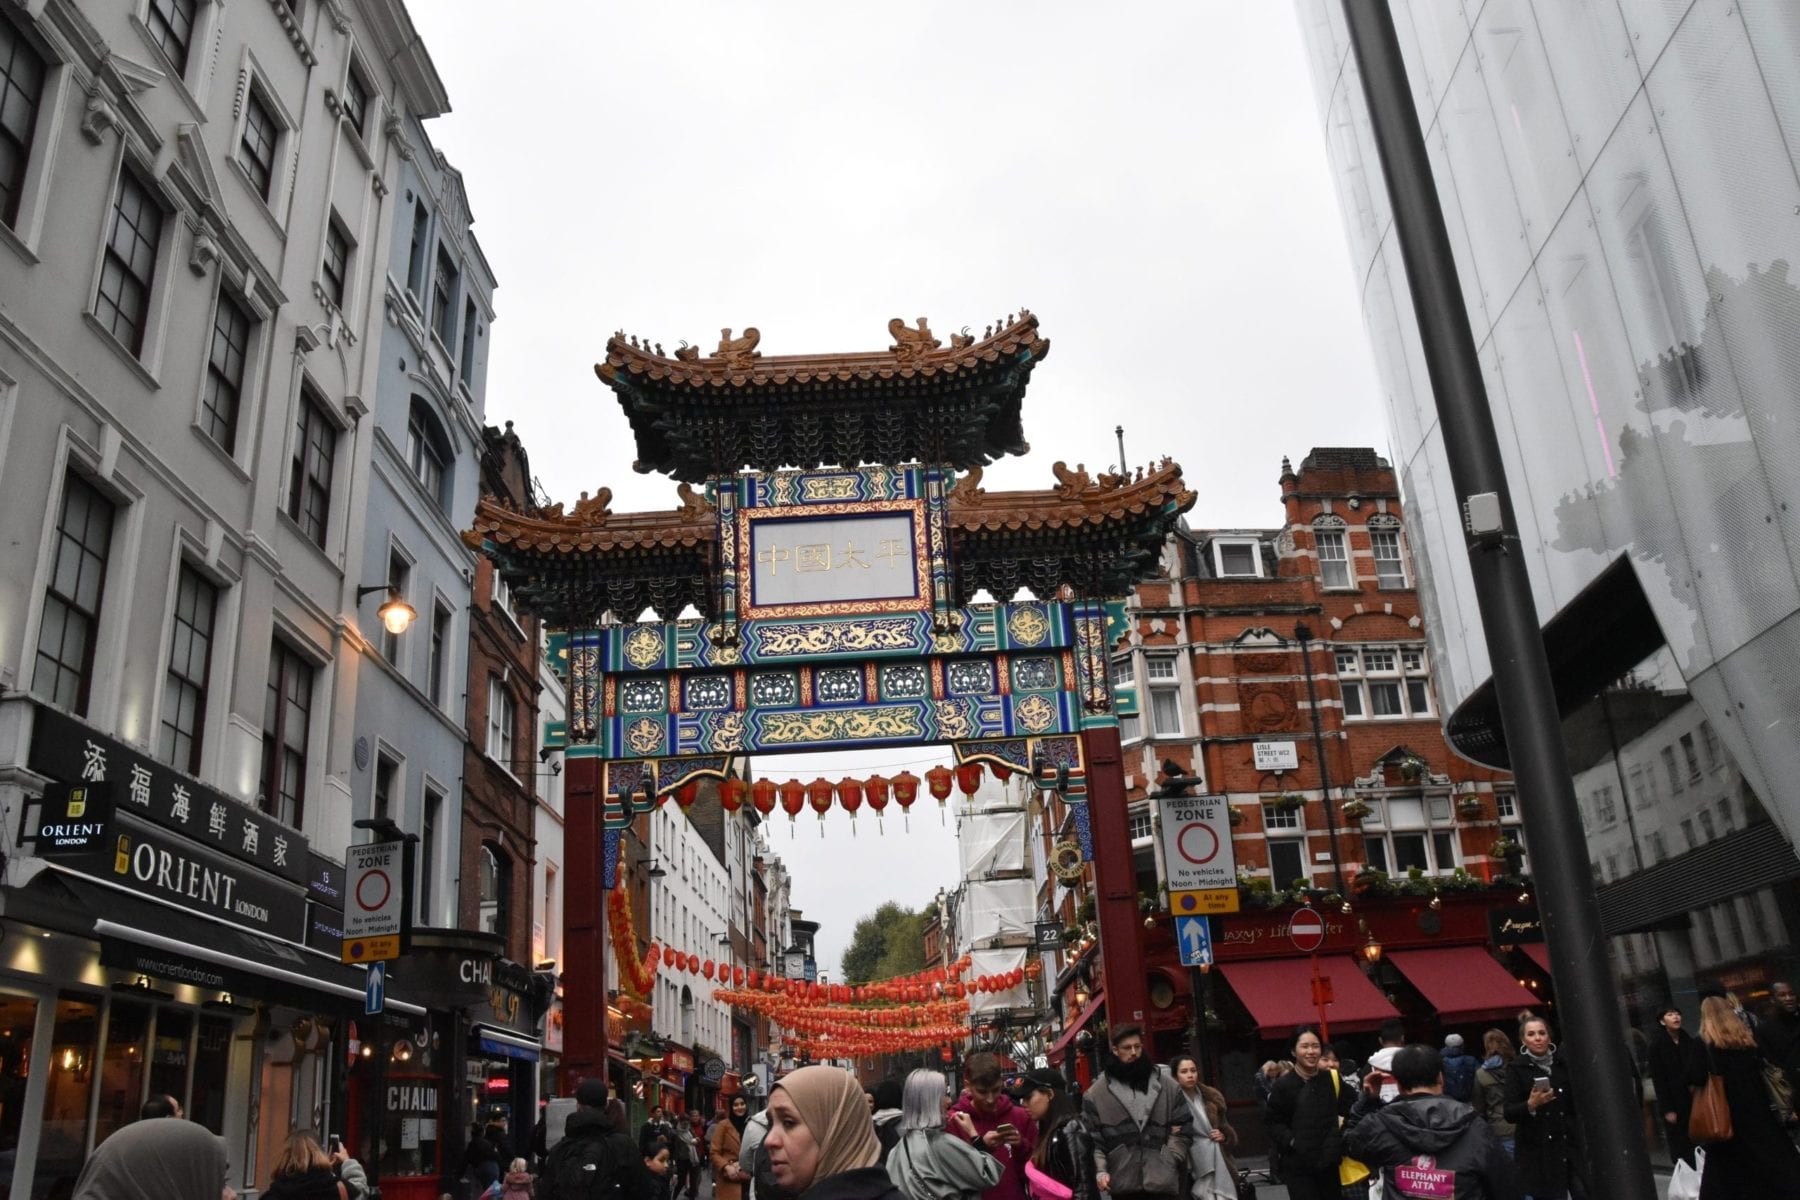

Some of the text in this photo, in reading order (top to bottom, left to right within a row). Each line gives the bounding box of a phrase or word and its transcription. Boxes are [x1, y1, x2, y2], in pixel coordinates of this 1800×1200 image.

[1166, 798, 1221, 809] PEDESTRIAN
[1175, 808, 1215, 822] ZONE
[41, 823, 104, 837] ORIENT
[55, 838, 88, 846] LONDON
[352, 845, 398, 856] PEDESTRIAN
[358, 856, 391, 869] ZONE
[1178, 868, 1224, 877] No vehicles
[133, 843, 269, 923] ORIENT LONDON
[1198, 878, 1233, 888] Midnight
[352, 914, 392, 925] No vehicles
[346, 928, 364, 936] Noon
[368, 924, 398, 932] Midnight
[1042, 930, 1058, 941] 22
[1400, 1170, 1447, 1183] ELEPHANT
[1411, 1180, 1435, 1191] ATTA
